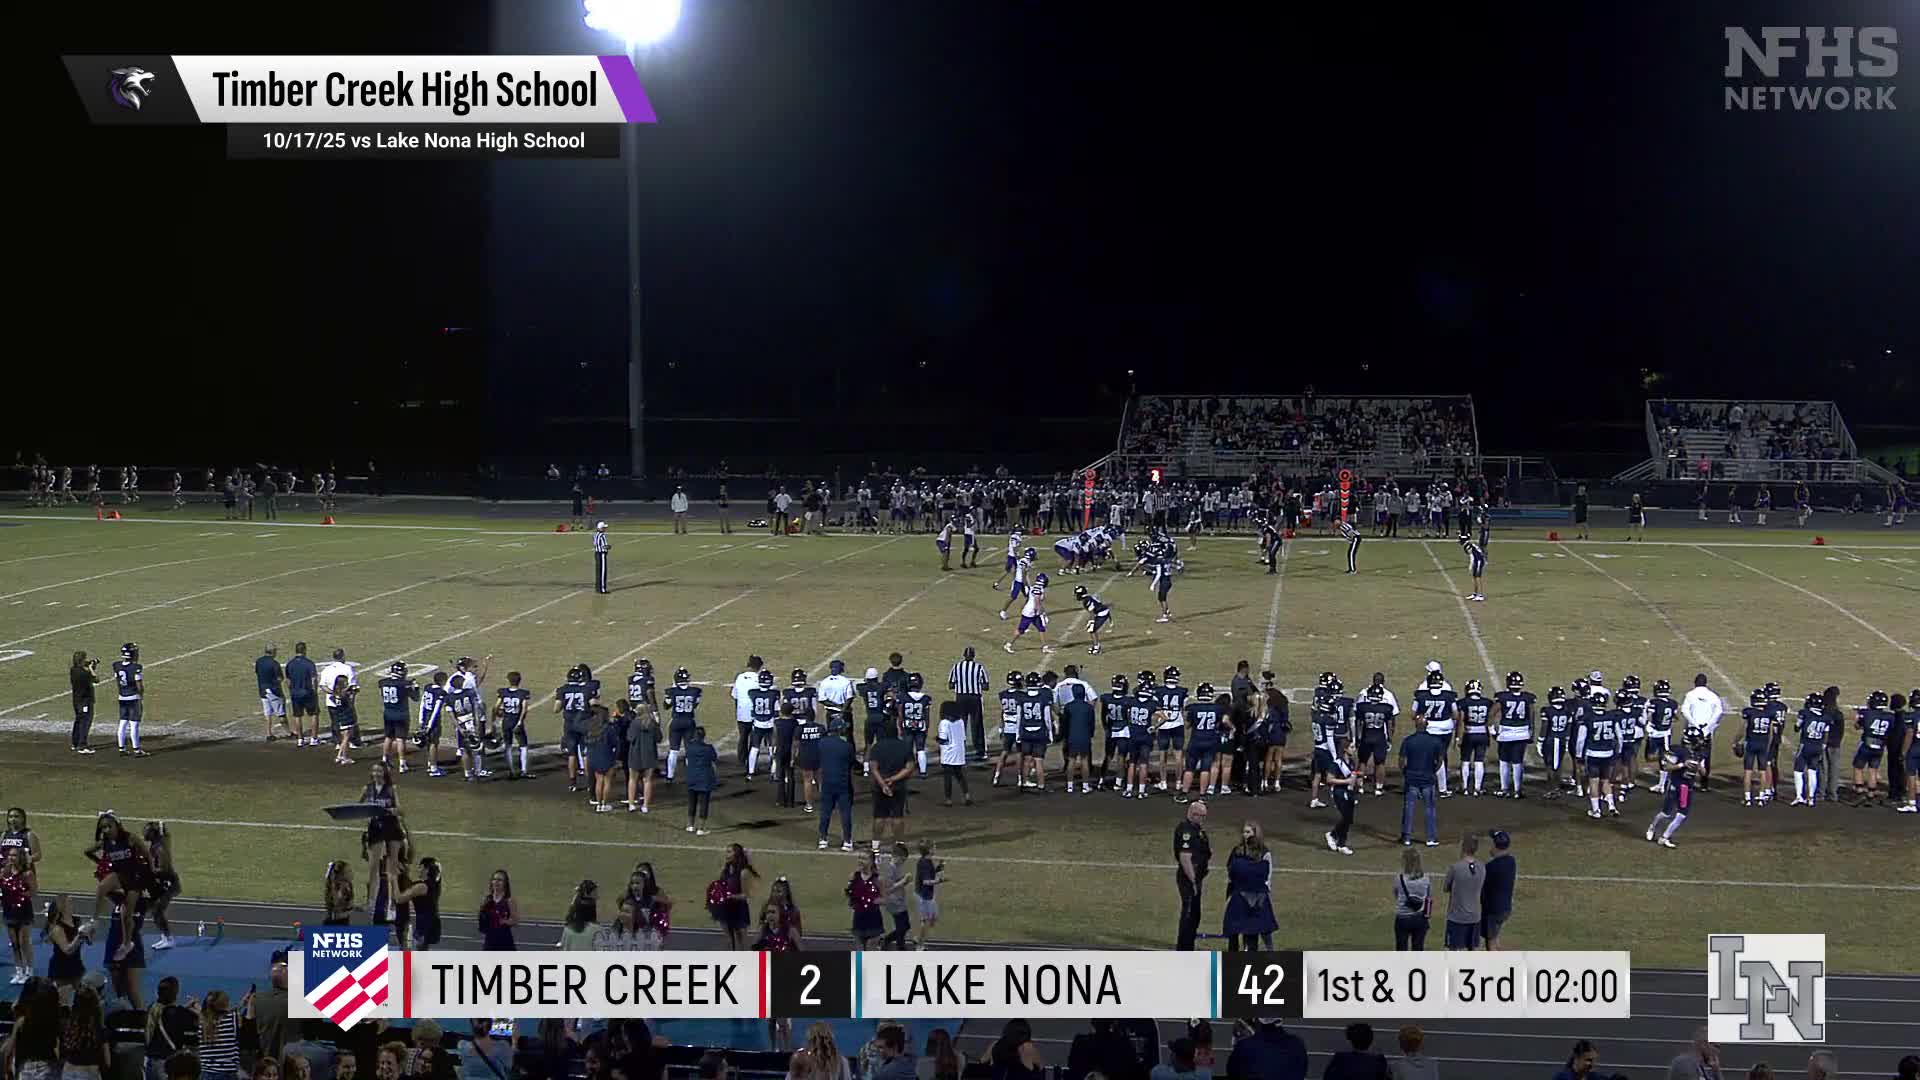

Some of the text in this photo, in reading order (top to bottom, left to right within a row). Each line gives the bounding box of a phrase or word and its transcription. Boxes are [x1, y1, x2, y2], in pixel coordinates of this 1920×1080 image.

[119, 670, 128, 686] 3
[565, 692, 585, 711] 73
[675, 695, 693, 713] 56
[755, 697, 771, 715] 81
[867, 691, 878, 708] 5
[1162, 694, 1179, 710] 14
[904, 702, 923, 720] 23
[1023, 702, 1042, 720] 54
[1424, 700, 1446, 718] 77
[1467, 705, 1488, 724] 52
[1505, 701, 1526, 719] 74
[1662, 708, 1673, 726] 2
[1197, 711, 1216, 730] 72
[1593, 721, 1614, 741] 75
